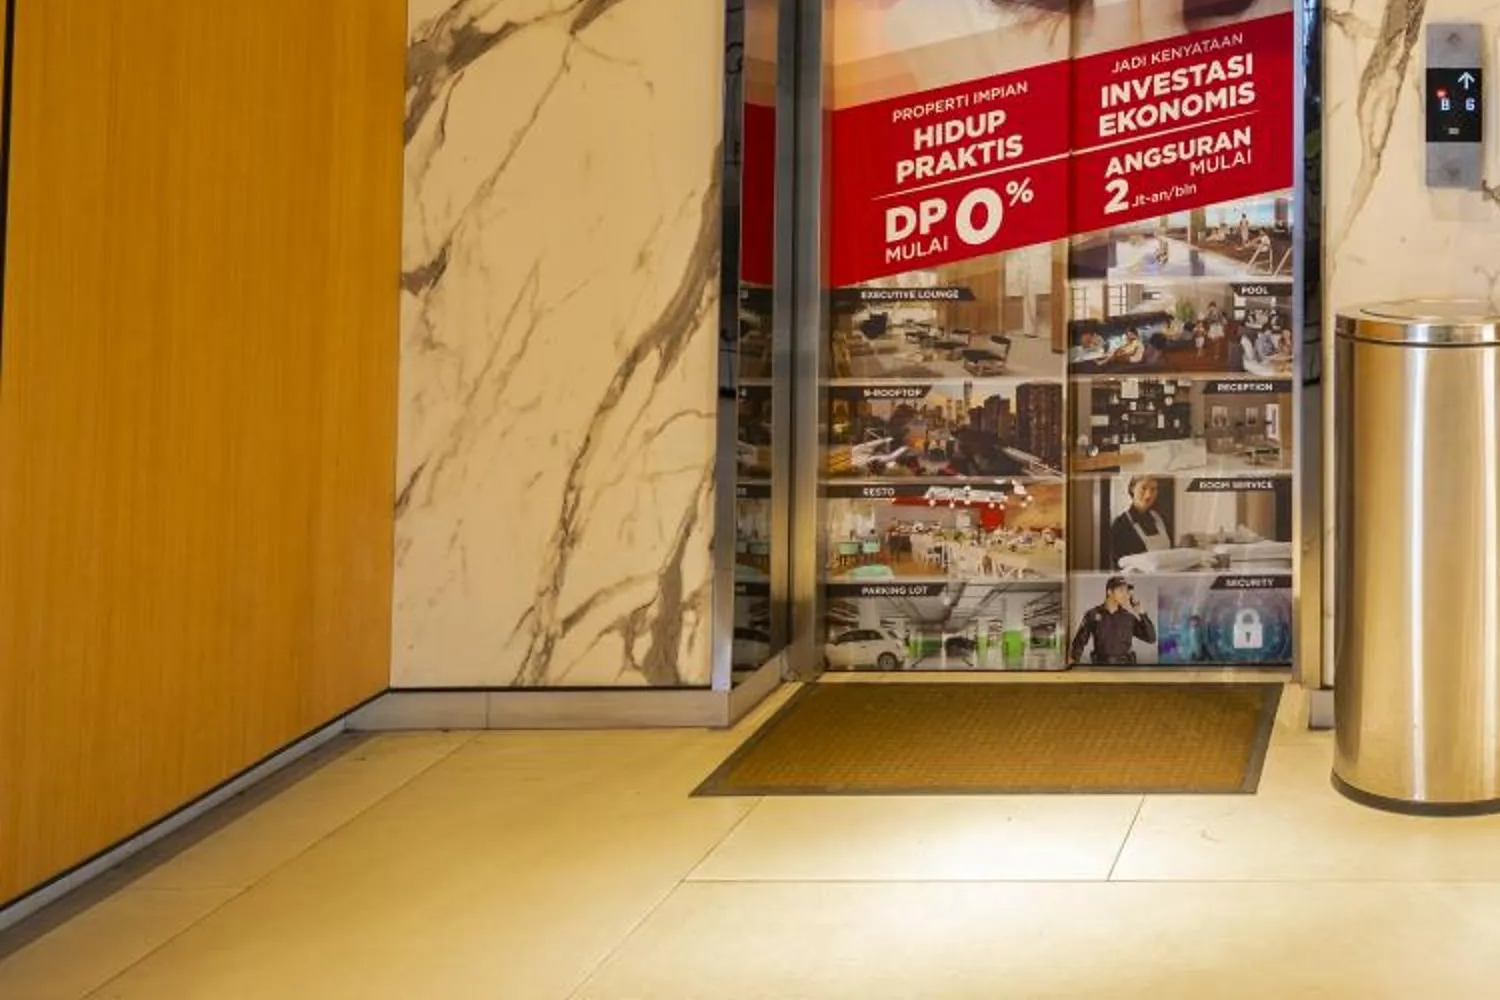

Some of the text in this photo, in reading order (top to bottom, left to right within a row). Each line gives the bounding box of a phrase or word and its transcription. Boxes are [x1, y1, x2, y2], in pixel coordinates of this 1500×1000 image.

[1111, 32, 1243, 74] JADI KENYATAAN
[1101, 53, 1254, 109] INVESTASI
[892, 81, 1028, 123] PROPERTI IMPIAN
[1099, 81, 1256, 138] EKONOMIS
[913, 109, 1007, 151] HIDUP
[896, 134, 1024, 185] PRAKTIS
[1104, 125, 1251, 179] ANGSURAN
[1189, 149, 1252, 177] MULAI
[1103, 178, 1130, 215] 2
[885, 198, 948, 243] DP
[885, 235, 949, 265] MULAI
[861, 289, 959, 299] EXECUTIVE LOUNGE
[1241, 286, 1269, 295] POOL
[1217, 383, 1274, 393] RECEPTION
[1199, 481, 1231, 489] ROOM
[861, 585, 929, 596] PARKING LOT
[1225, 579, 1275, 588] SECURITY
